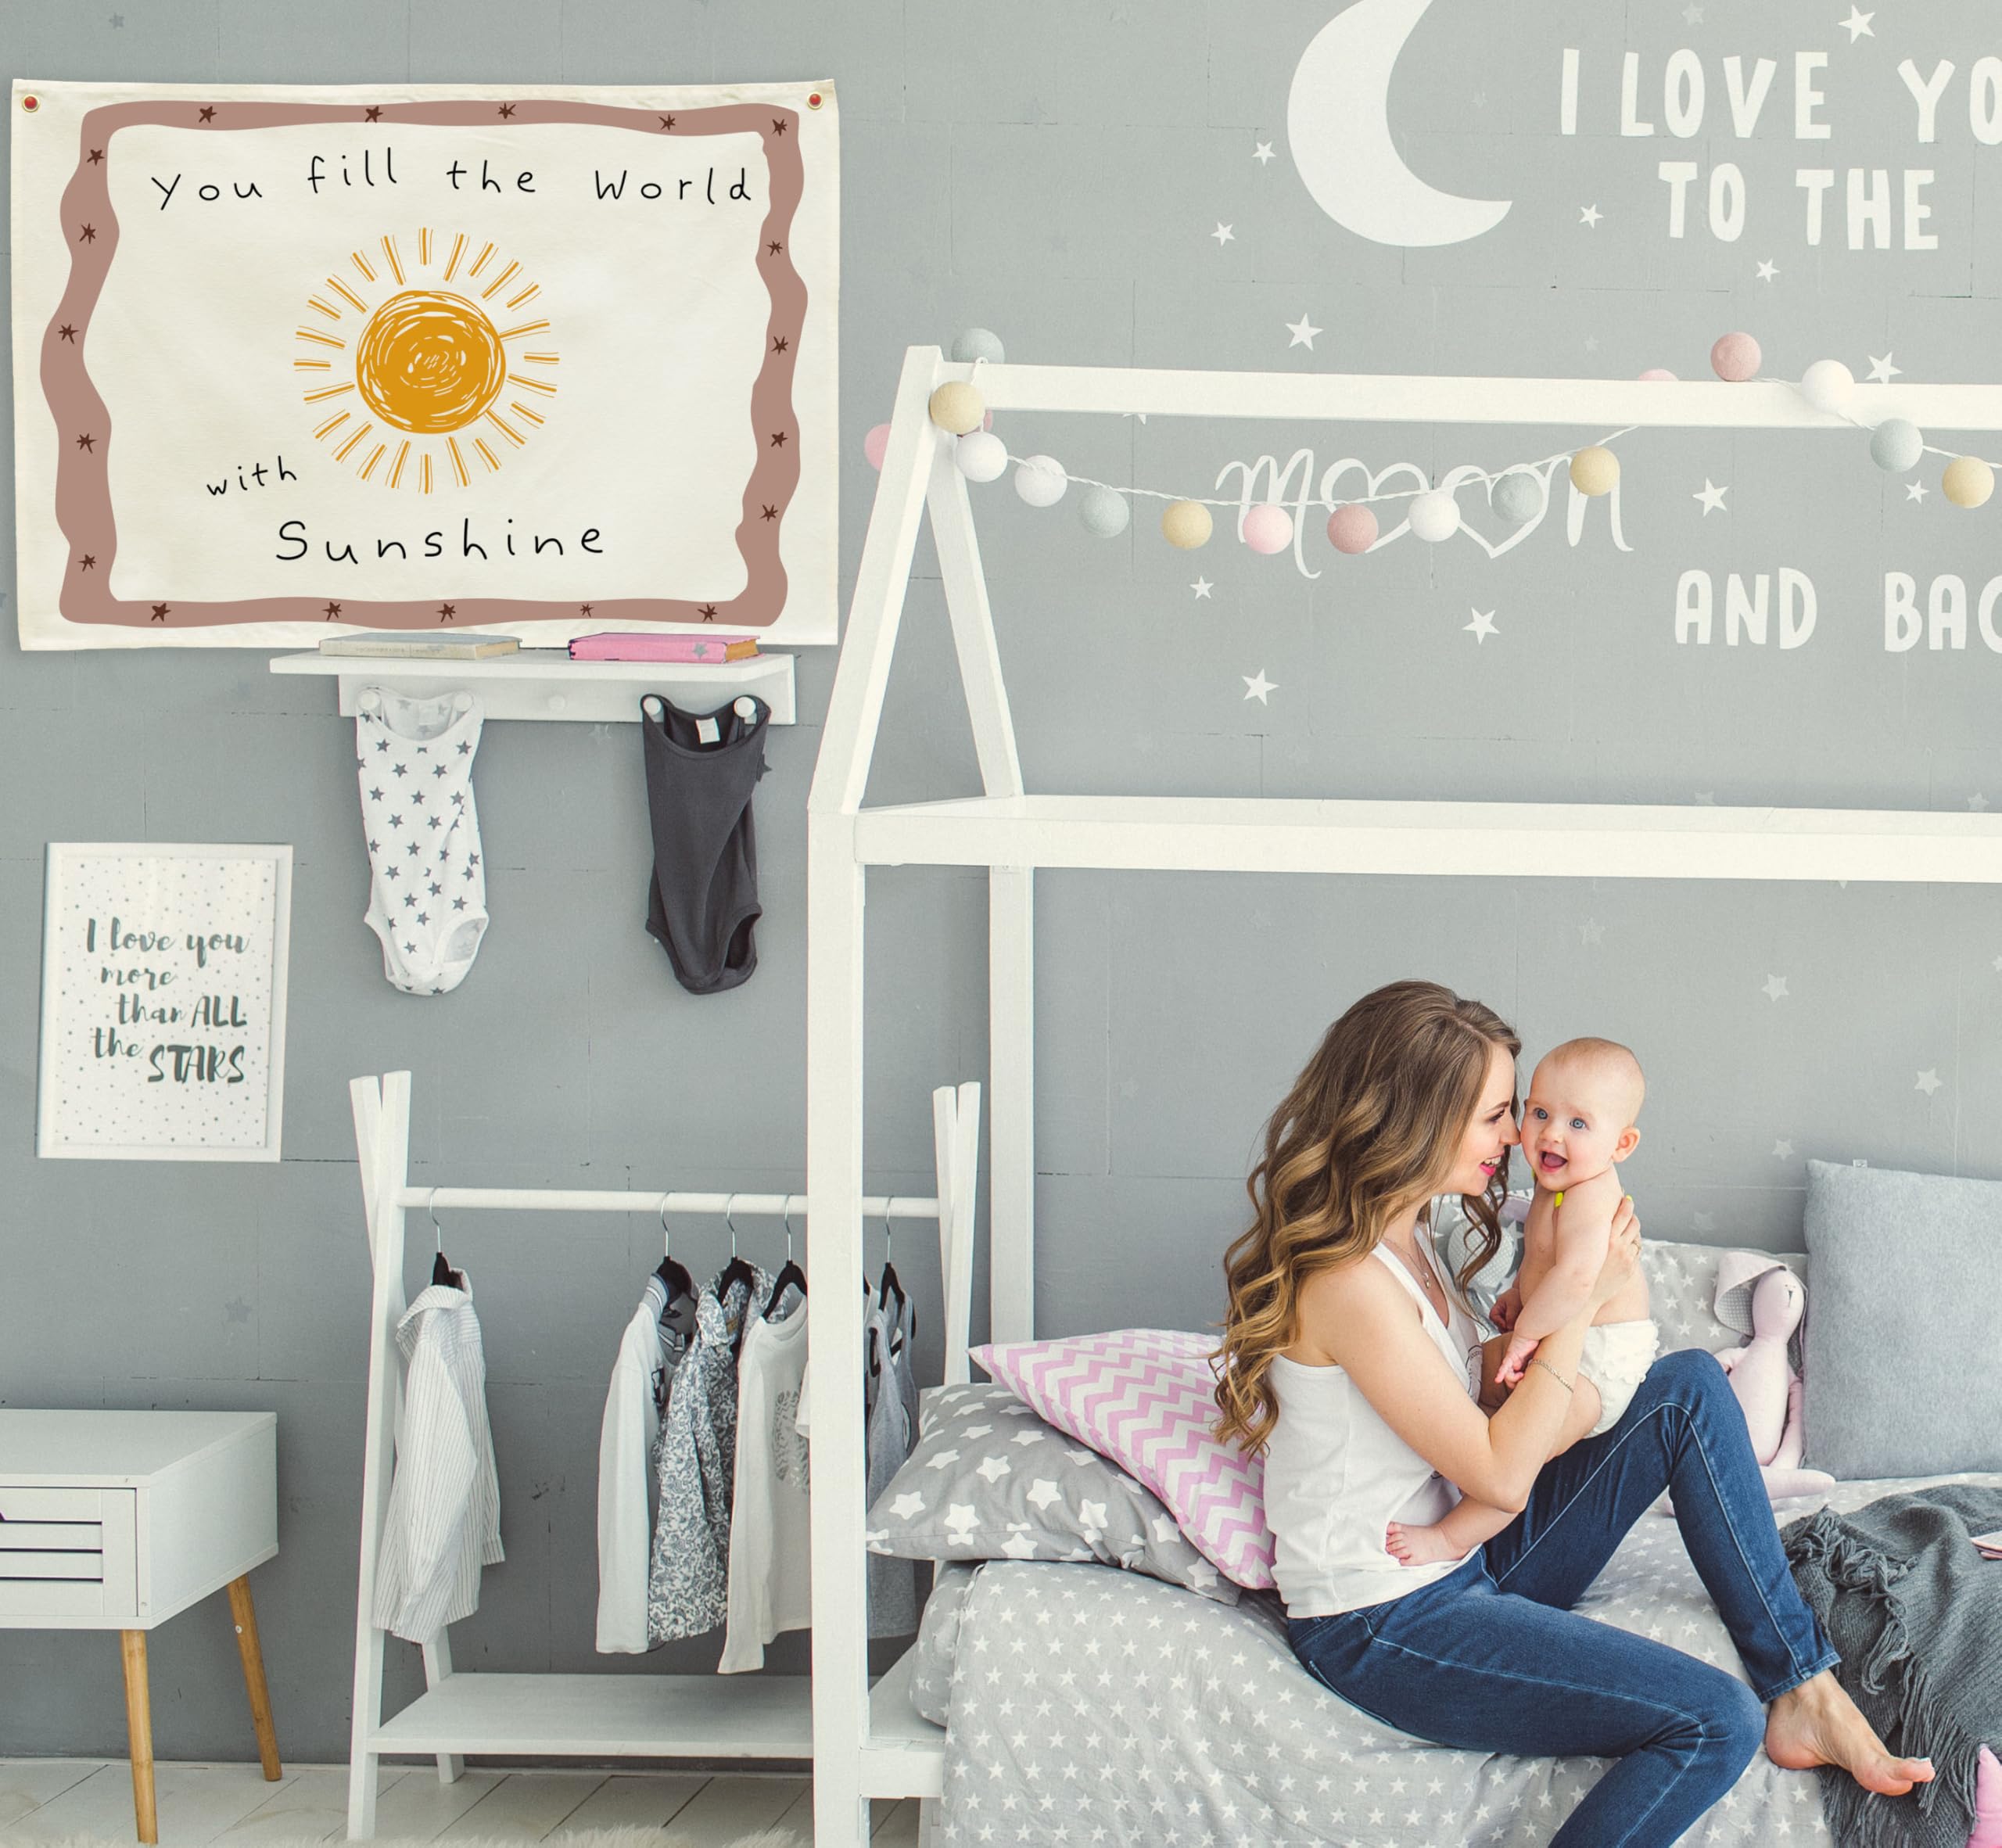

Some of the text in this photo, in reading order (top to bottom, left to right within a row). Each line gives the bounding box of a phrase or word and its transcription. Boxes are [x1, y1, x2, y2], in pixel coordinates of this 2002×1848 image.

[1560, 48, 1580, 135] I
[1620, 48, 1832, 138] LOVE
[151, 146, 752, 211] You fill the World
[1658, 161, 1939, 251] TO THE
[206, 455, 297, 496] with
[276, 518, 603, 565] Sunshine
[1674, 567, 1817, 650] AND
[86, 917, 250, 968] I love you
[100, 967, 178, 991] more
[114, 992, 247, 1028] than ALL
[90, 1026, 245, 1084] the STARS
